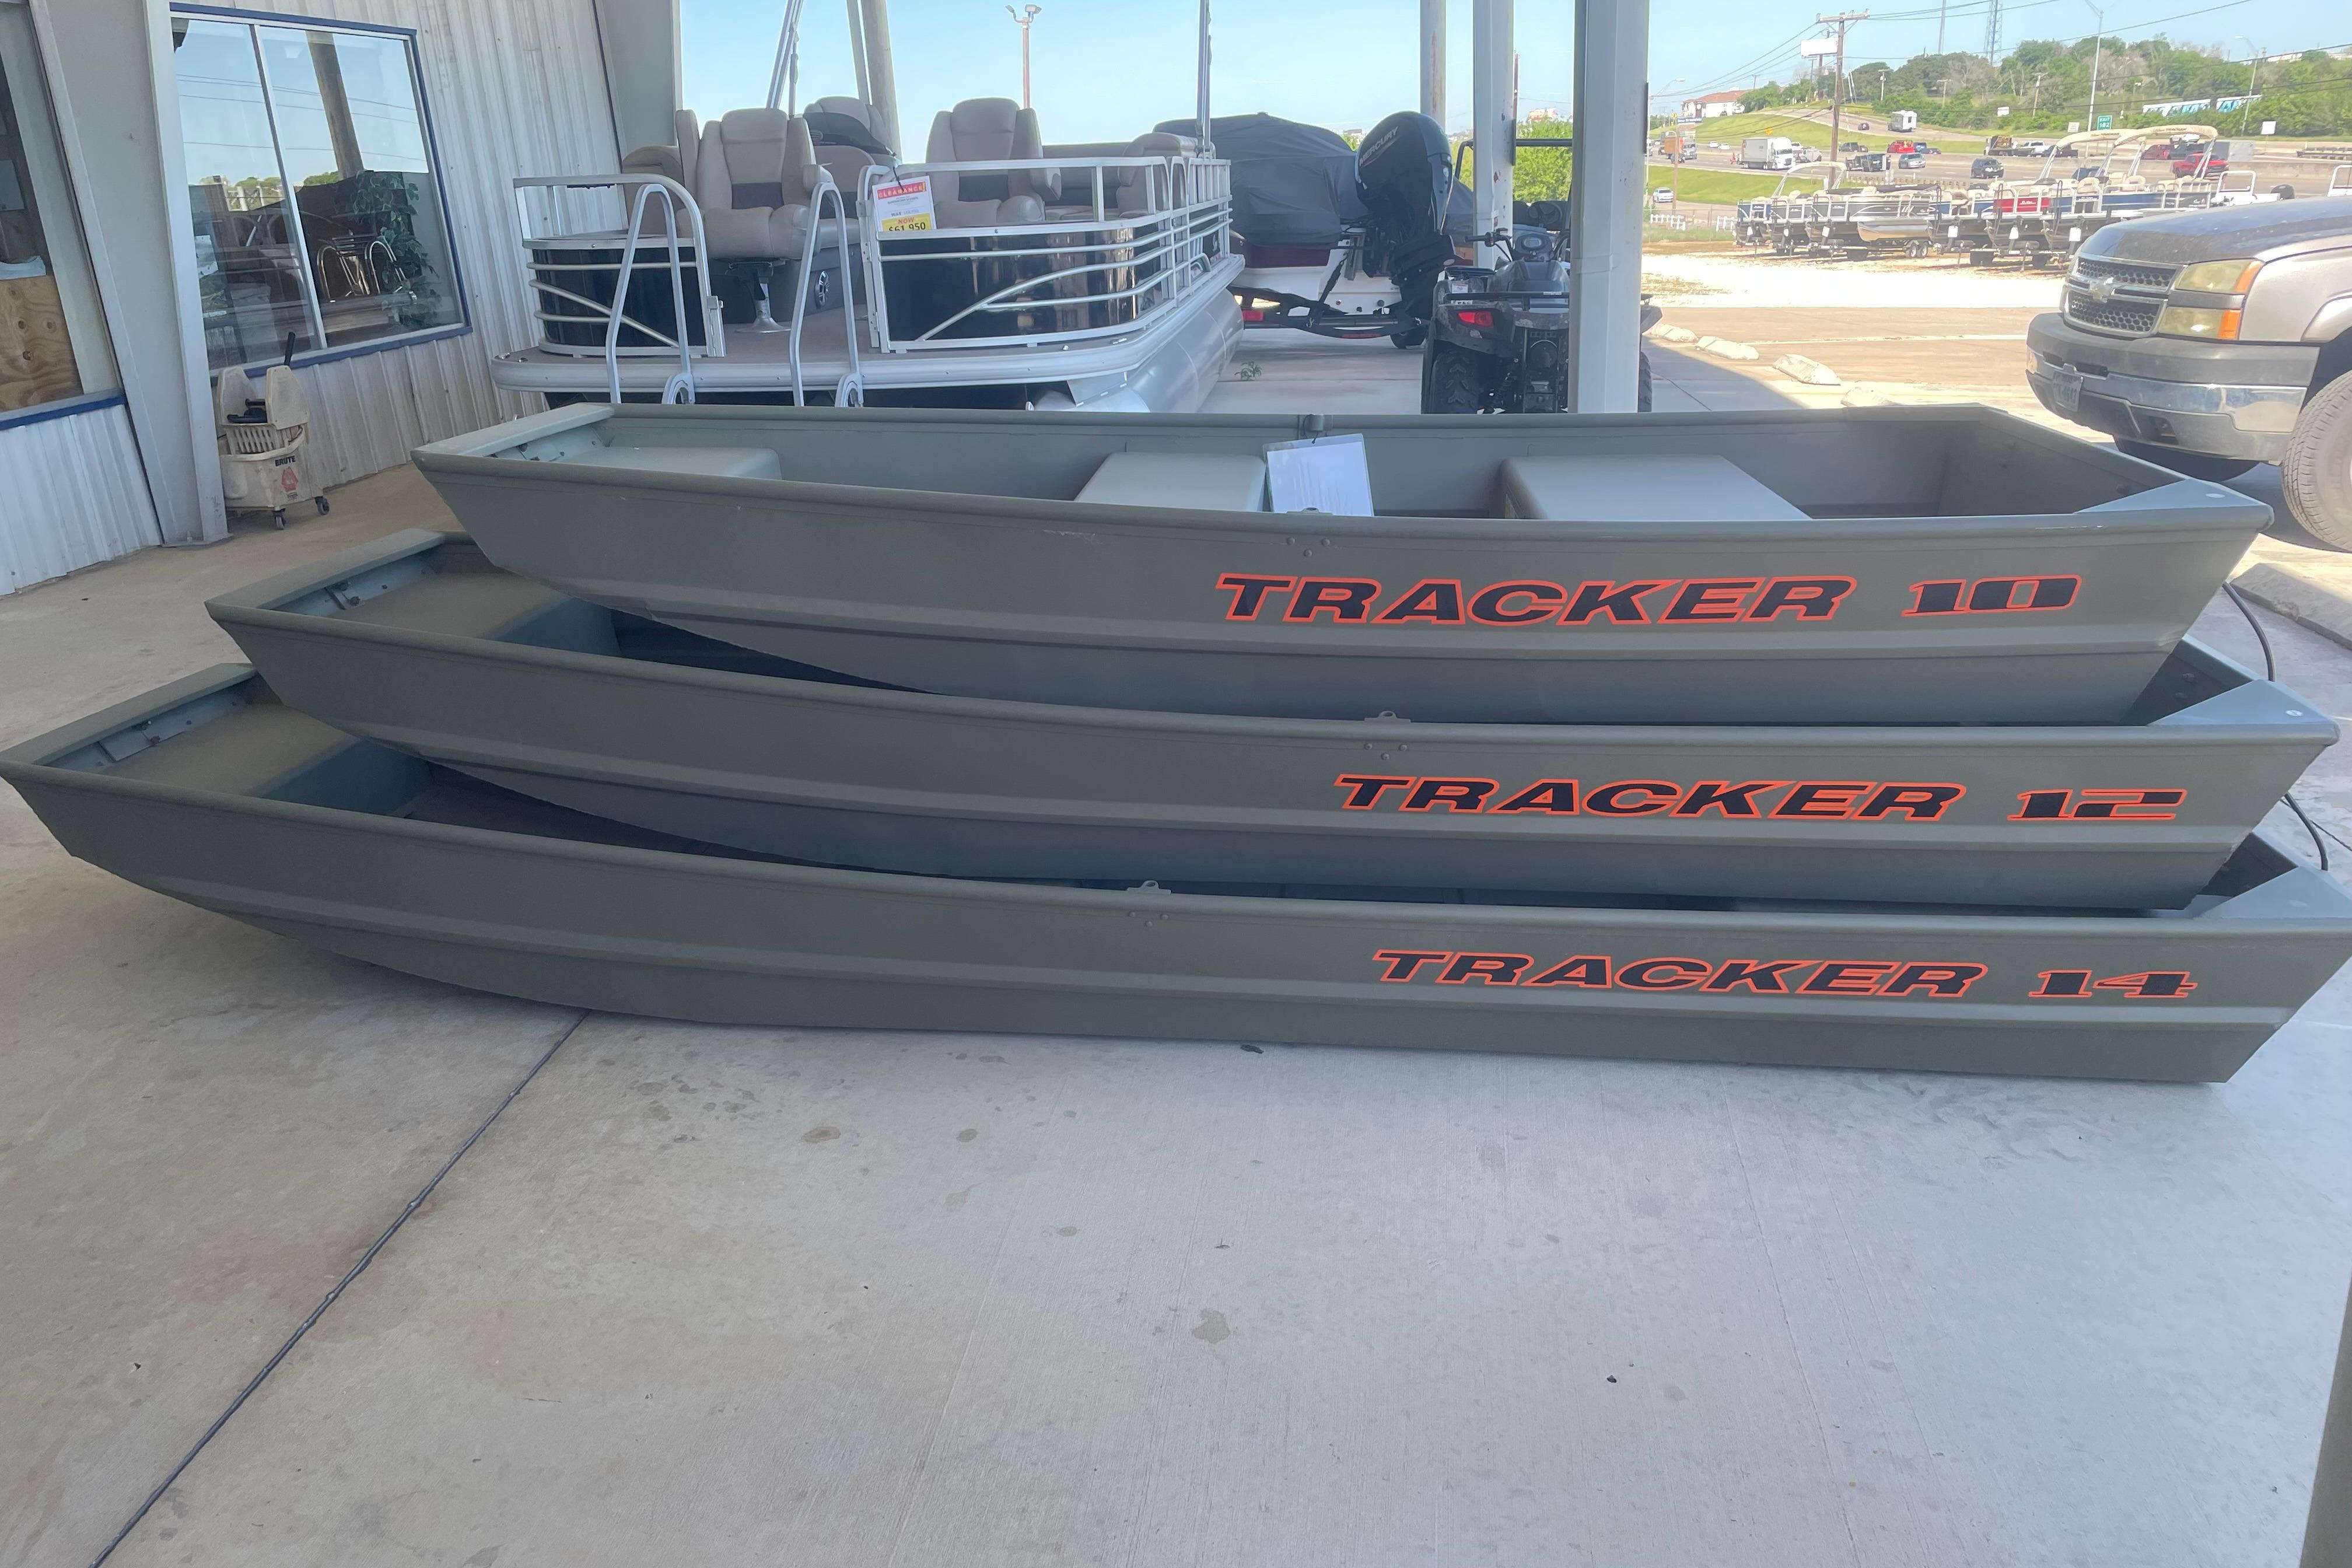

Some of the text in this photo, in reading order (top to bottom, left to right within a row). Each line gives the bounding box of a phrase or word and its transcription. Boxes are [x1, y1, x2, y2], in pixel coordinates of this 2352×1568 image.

[1359, 125, 1398, 168] MERCURY
[275, 455, 296, 467] BRUTE
[1216, 573, 2081, 625] TRACKER 10
[1335, 774, 2188, 821] TRACKER 12
[1372, 949, 2197, 998] TRACKER 14
